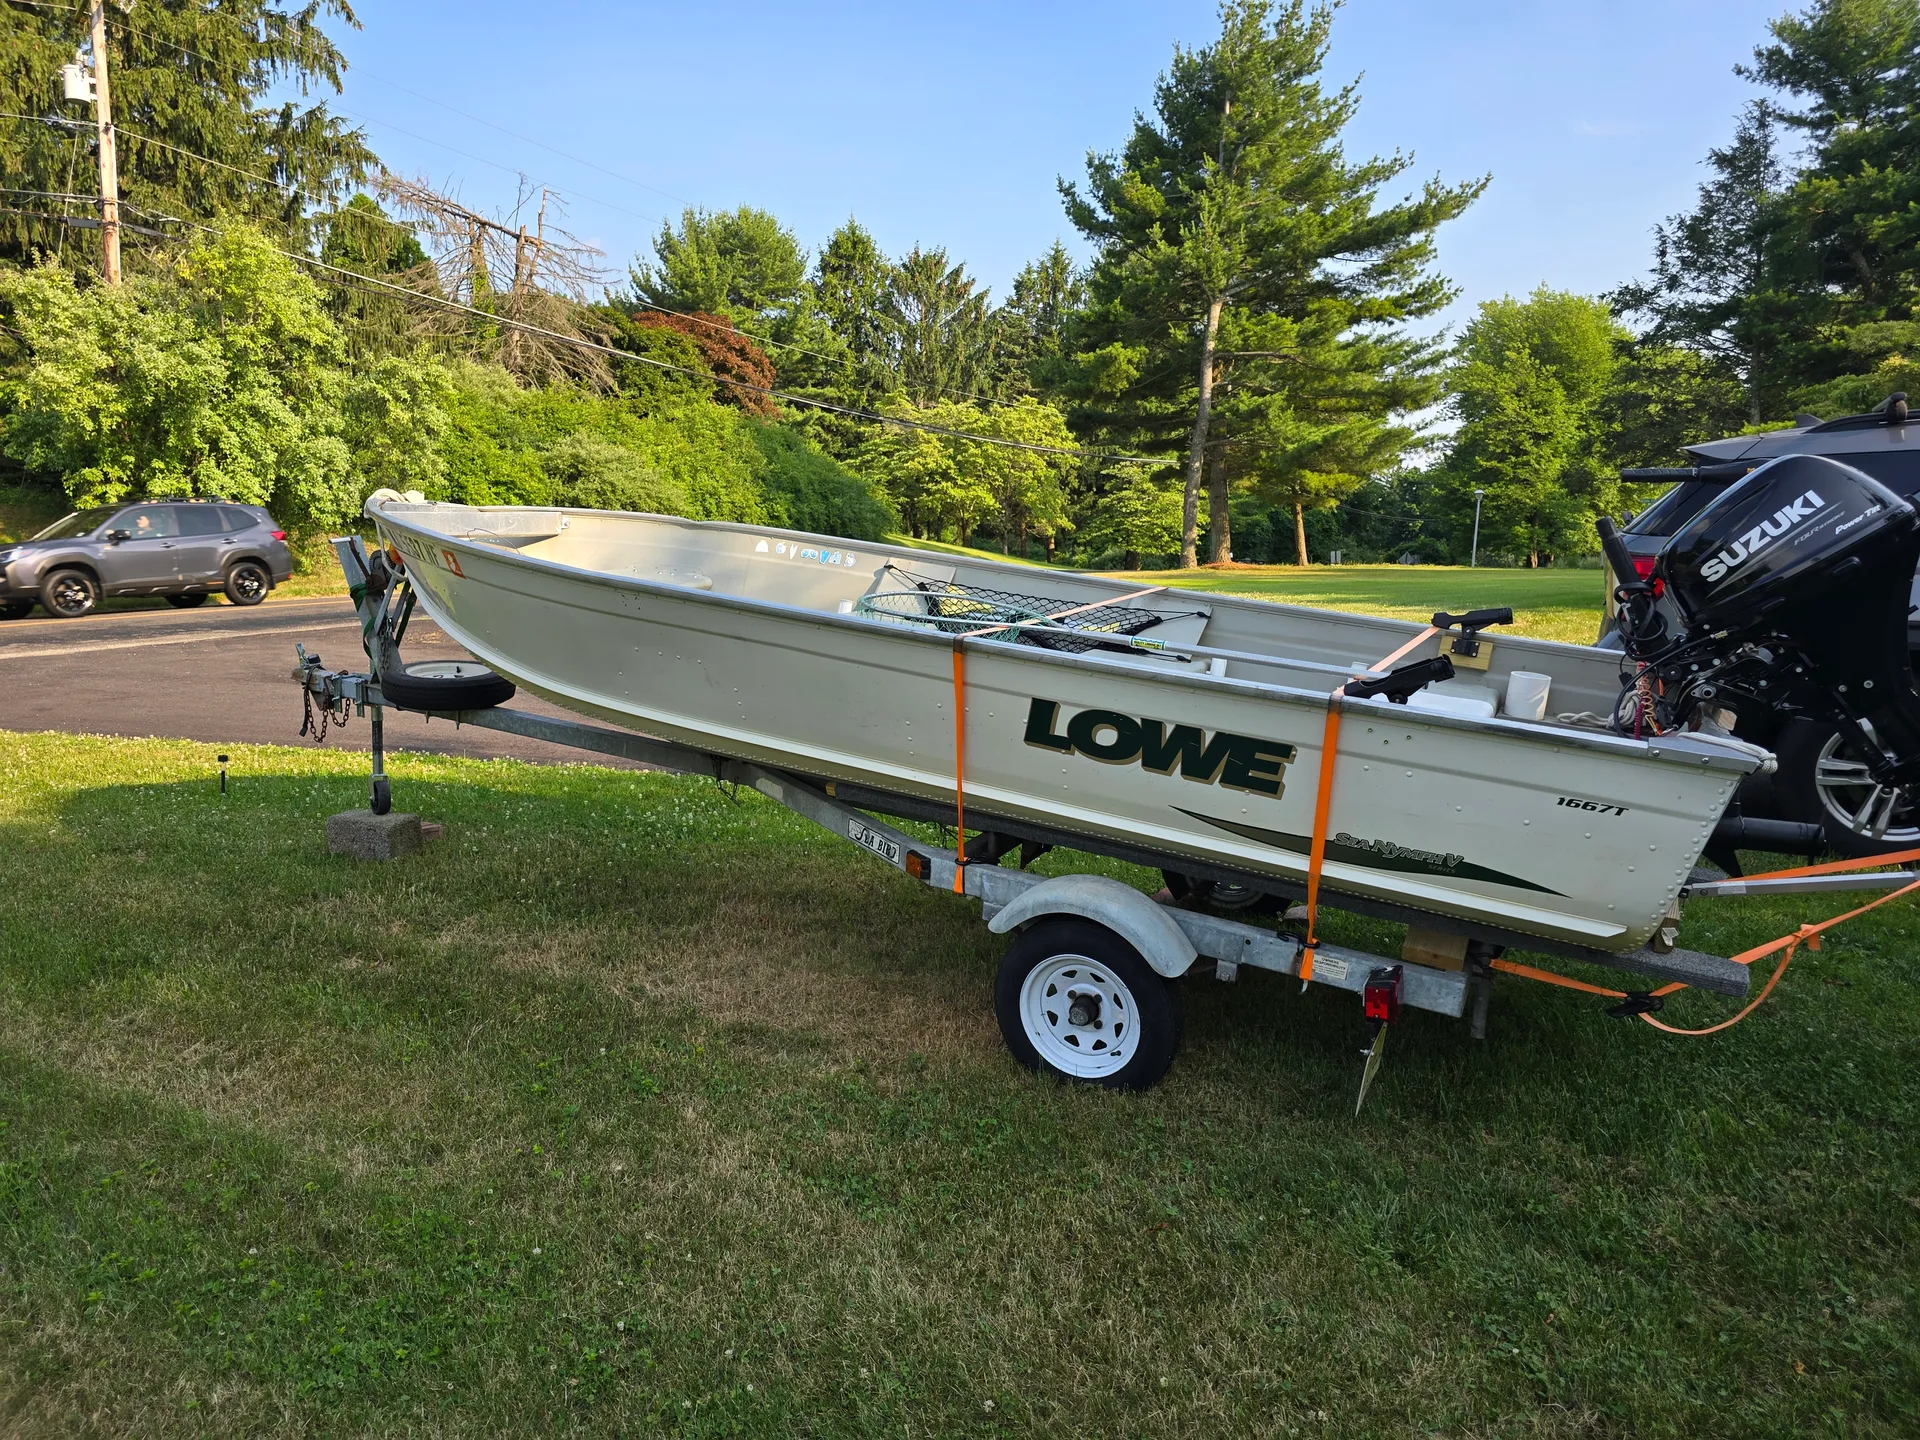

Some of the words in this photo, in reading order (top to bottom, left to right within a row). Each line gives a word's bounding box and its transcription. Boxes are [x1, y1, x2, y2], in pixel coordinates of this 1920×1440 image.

[1794, 526, 1820, 546] FOUR
[1819, 510, 1847, 530] STROKE
[1835, 514, 1865, 535] Power
[1864, 504, 1881, 517] Tilt
[1700, 489, 1826, 582] SUZUKI
[1024, 697, 1297, 800] LOWE
[1556, 797, 1630, 817] 1667T
[877, 839, 897, 859] BIRD
[1445, 852, 1465, 868] V
[1427, 864, 1456, 875] SERIES
